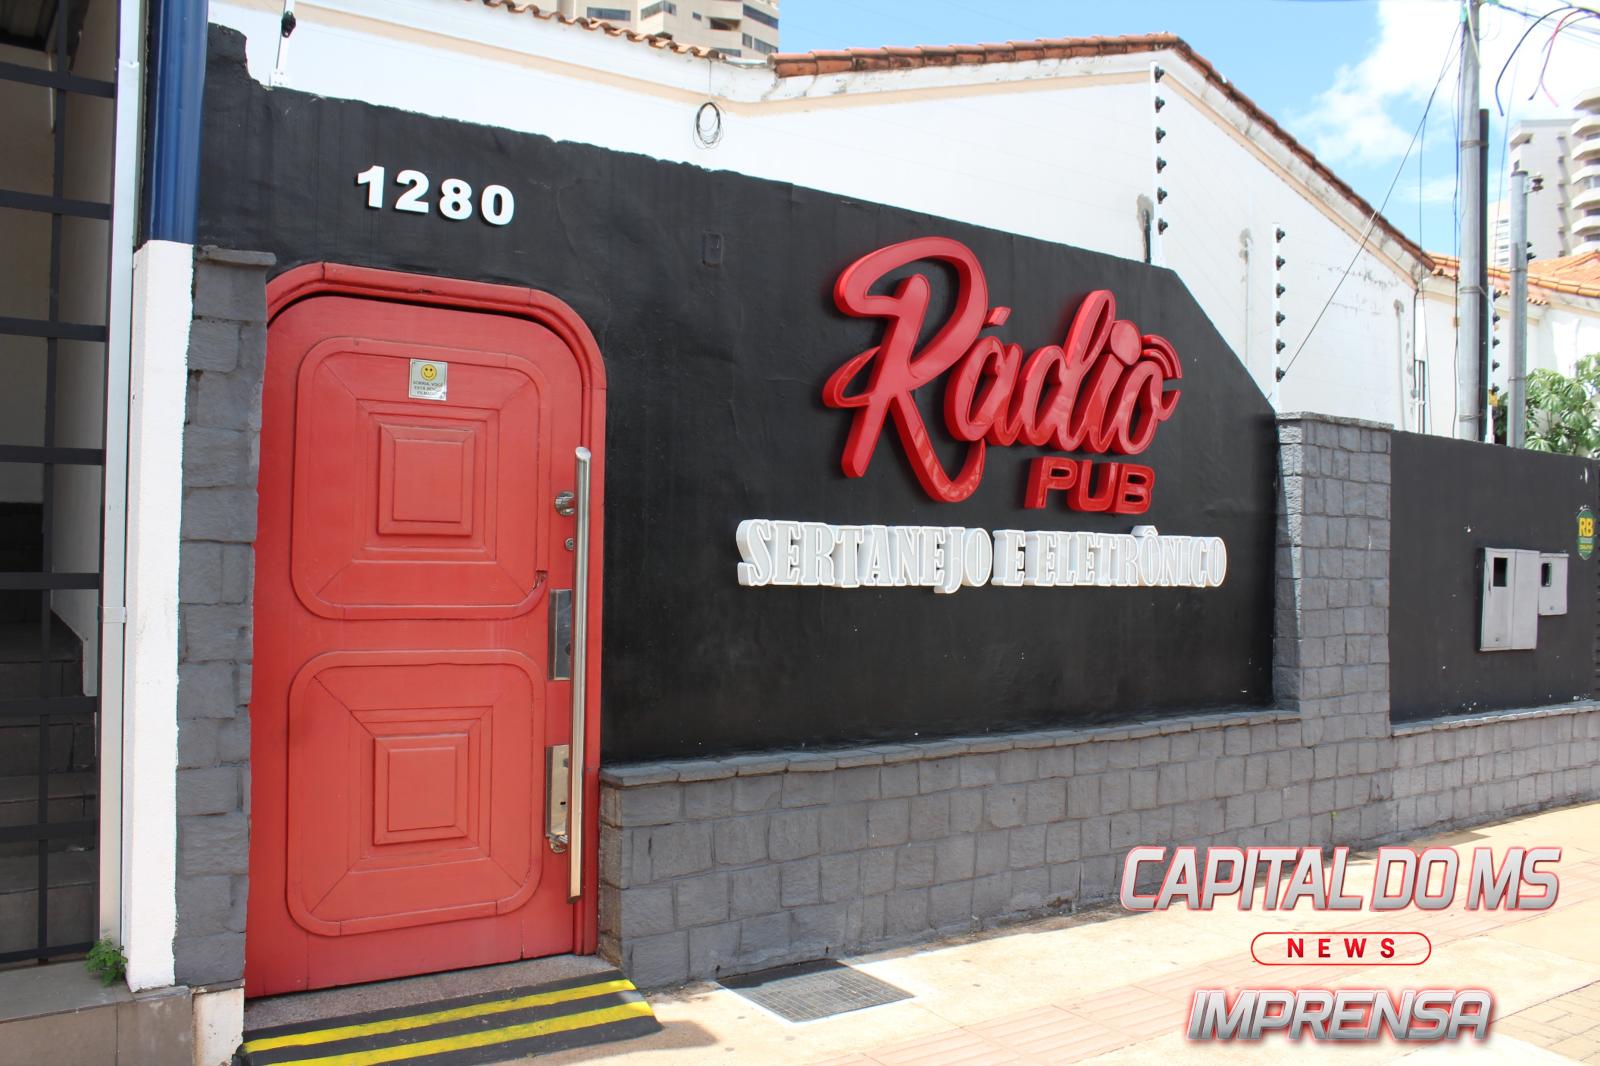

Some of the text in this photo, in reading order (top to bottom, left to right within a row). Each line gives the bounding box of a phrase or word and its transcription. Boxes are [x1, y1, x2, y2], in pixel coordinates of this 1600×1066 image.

[356, 165, 514, 226] 1280
[823, 236, 1182, 502] Rádio
[1024, 456, 1155, 514] PUB
[736, 519, 1227, 594] SERTANEJO E ELETRÔNICO
[1579, 518, 1594, 537] RB
